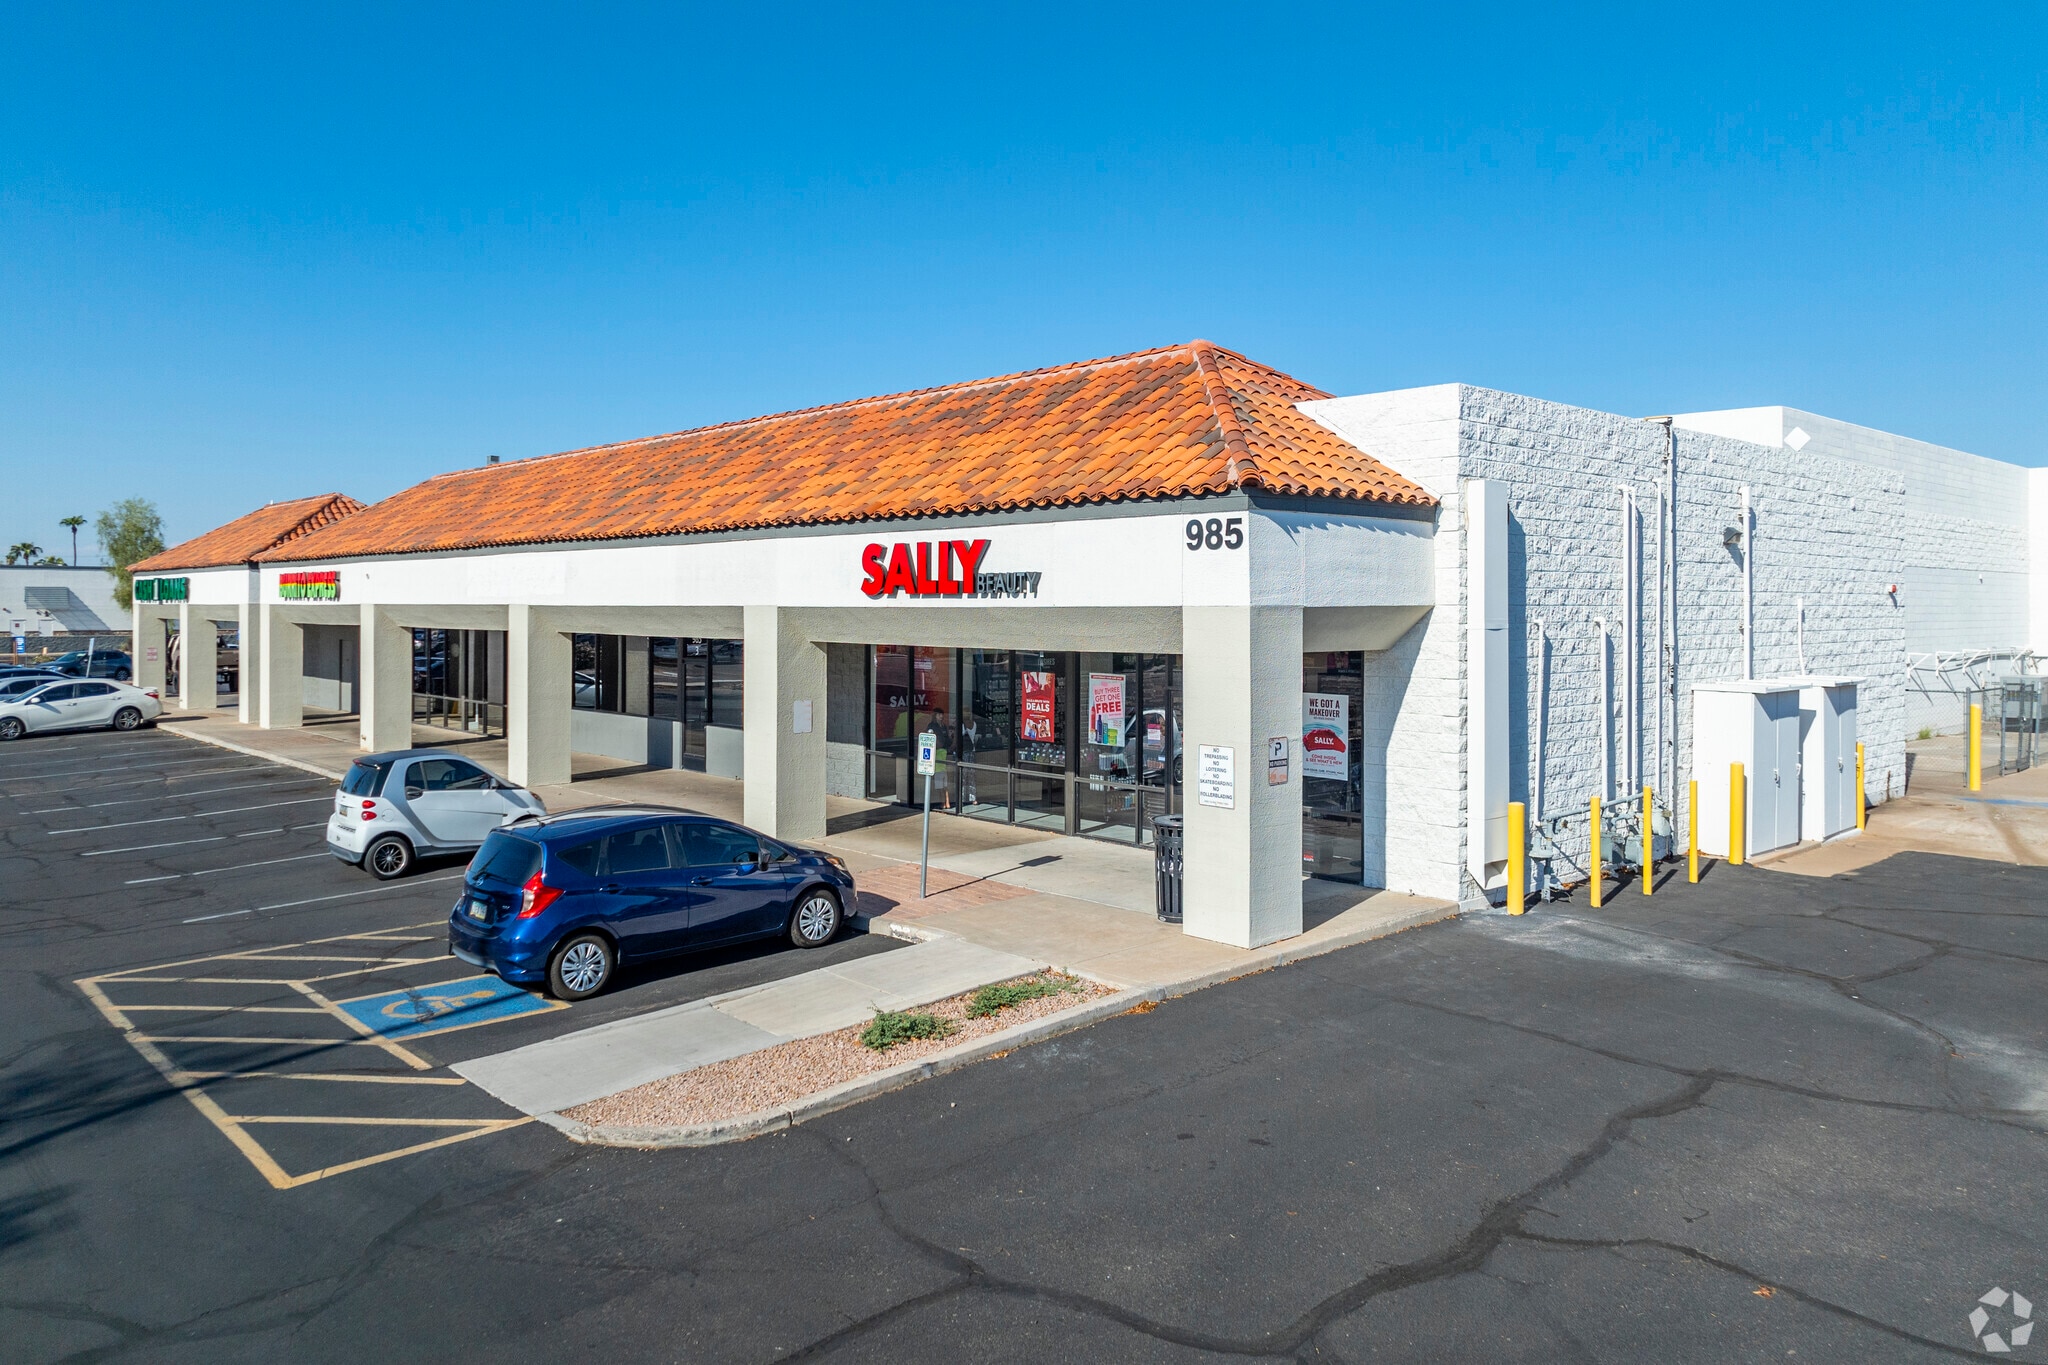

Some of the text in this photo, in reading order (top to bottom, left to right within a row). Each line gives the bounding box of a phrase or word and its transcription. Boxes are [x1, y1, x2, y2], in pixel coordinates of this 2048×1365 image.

[1185, 518, 1243, 551] 985
[861, 539, 1041, 598] SALLY BEAUTY
[1105, 686, 1120, 694] THREE
[1095, 693, 1121, 702] GET ONE
[1026, 702, 1050, 712] DEALS
[1096, 701, 1122, 714] FREE
[1309, 698, 1340, 709] WE GOT A
[1309, 708, 1340, 718] MAKEOVER
[1314, 736, 1334, 745] SALLY.
[1199, 779, 1233, 787] SKATEBOARDING
[1200, 791, 1233, 800] ROLLERBLADING
